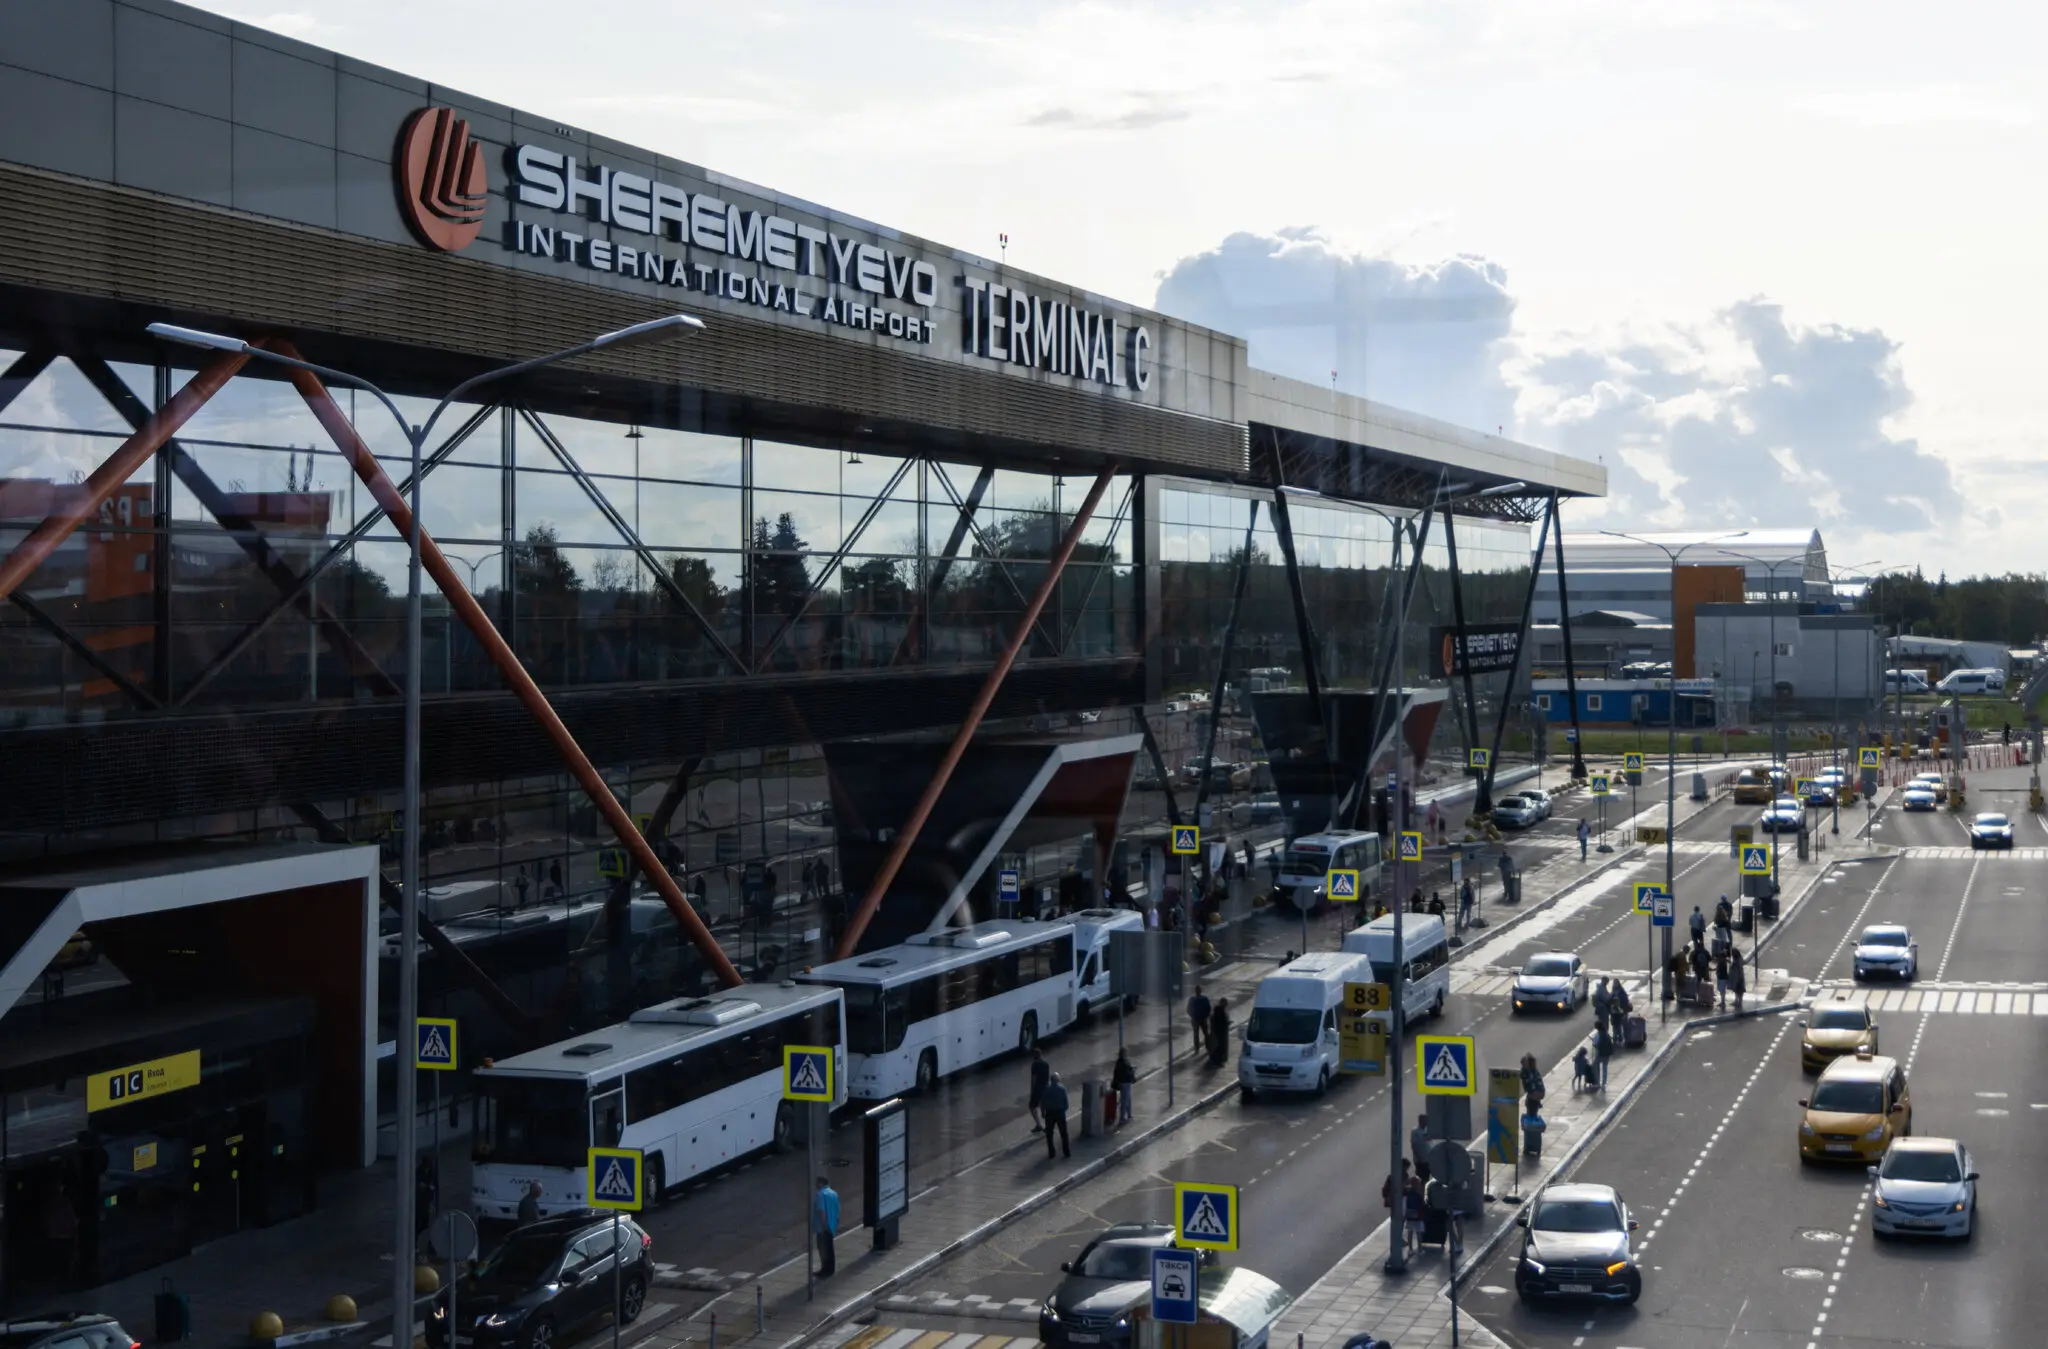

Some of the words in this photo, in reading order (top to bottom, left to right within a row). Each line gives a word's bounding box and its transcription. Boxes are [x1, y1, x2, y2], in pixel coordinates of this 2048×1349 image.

[516, 220, 811, 316] INTERNATIONAL
[823, 296, 938, 344] AIRPORT
[517, 143, 938, 308] SHEREMETYEVO
[964, 275, 1127, 387] TERMINAL
[1134, 326, 1151, 392] C
[1642, 829, 1659, 841] 87
[1353, 987, 1380, 1006] 88
